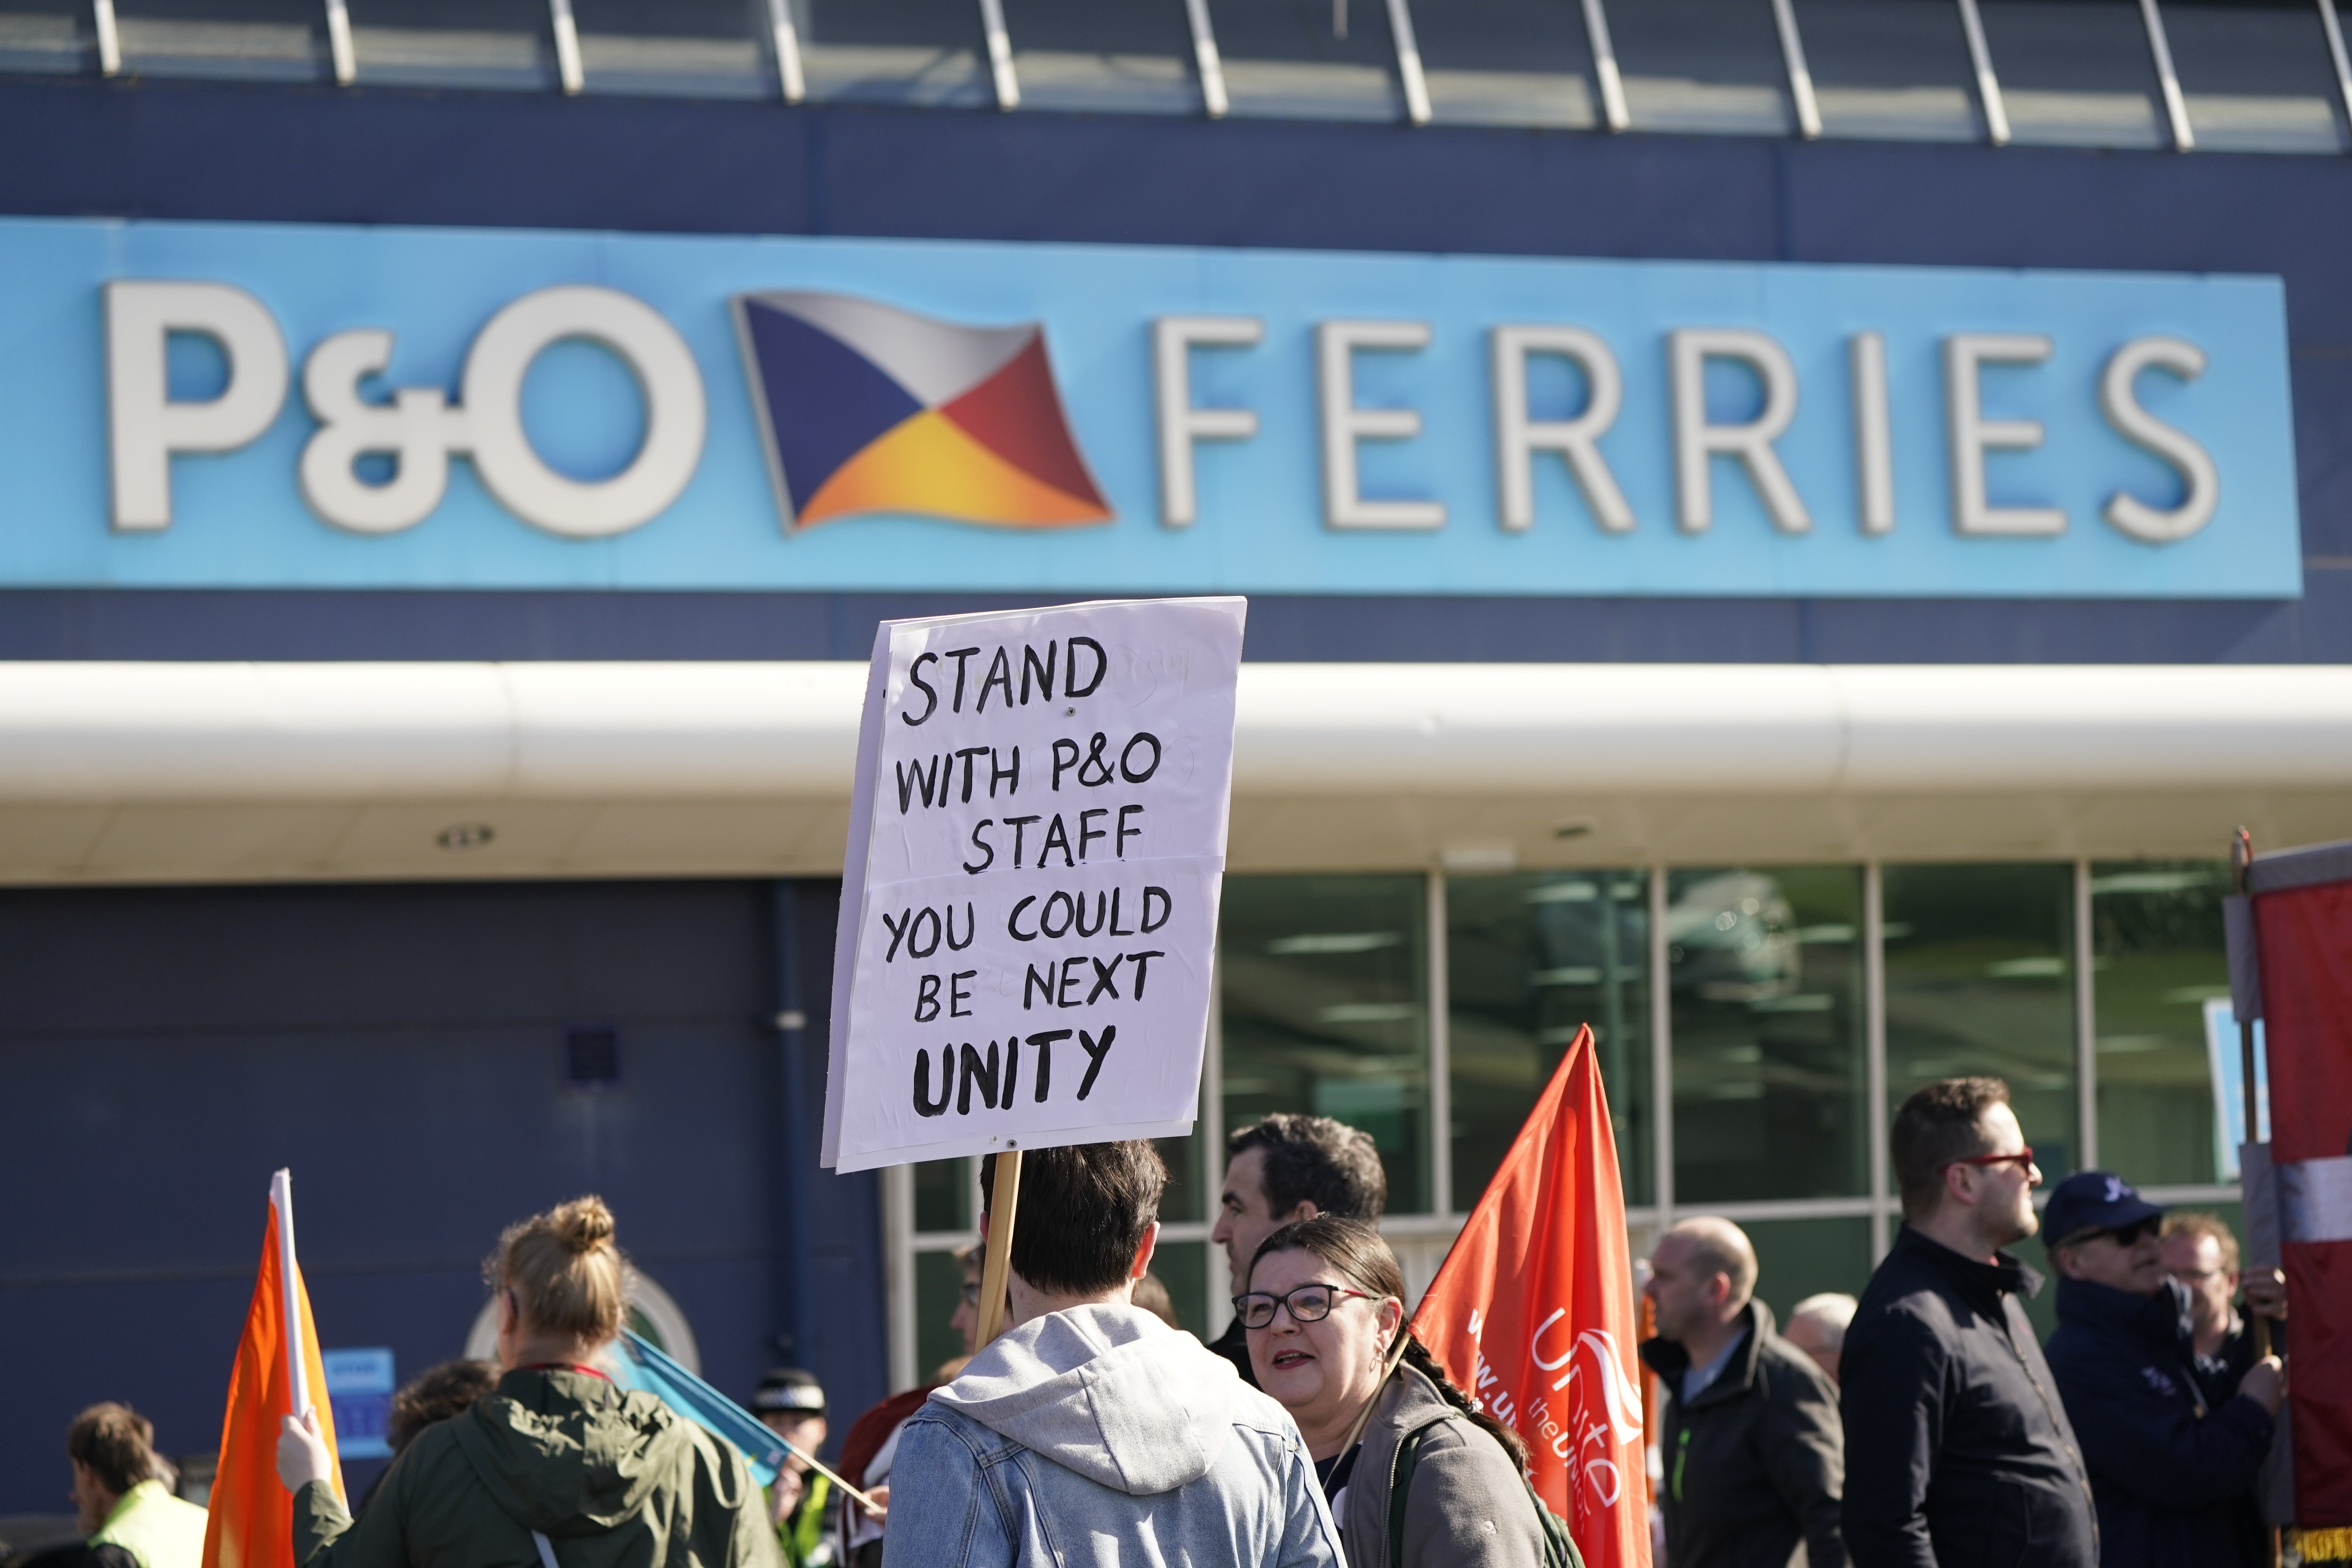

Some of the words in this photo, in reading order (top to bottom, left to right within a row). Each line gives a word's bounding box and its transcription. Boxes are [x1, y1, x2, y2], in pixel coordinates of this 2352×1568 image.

[104, 278, 707, 539] P&O
[1152, 316, 2220, 545] FERRIES
[902, 636, 1107, 727] STAND
[896, 745, 1021, 815] WITH
[1052, 731, 1162, 792] P&O
[962, 804, 1145, 874] STAFF
[882, 901, 975, 964] YOU
[1007, 886, 1172, 942] COULD
[914, 969, 978, 1023] BE
[1023, 950, 1165, 1011] NEXT
[913, 1024, 1116, 1118] UNITY
